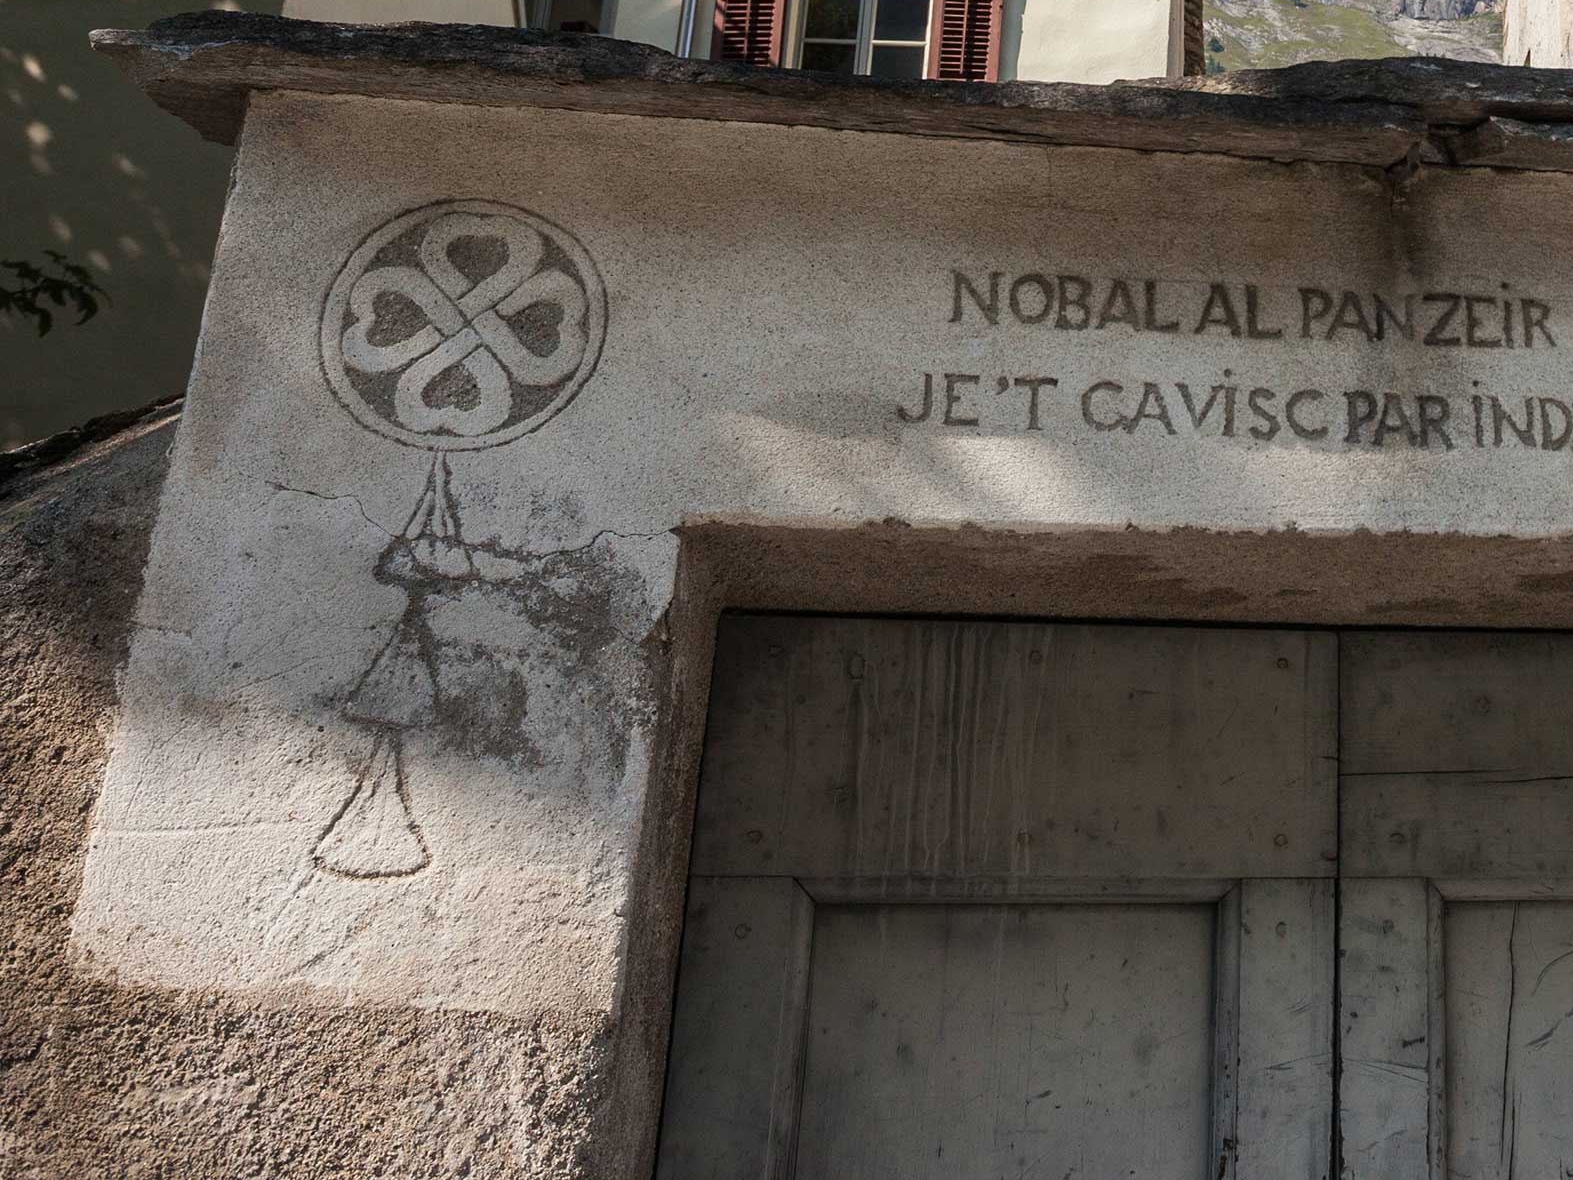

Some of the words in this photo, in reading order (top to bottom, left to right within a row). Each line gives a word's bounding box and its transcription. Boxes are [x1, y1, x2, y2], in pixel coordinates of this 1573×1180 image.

[948, 269, 1180, 331] NOBAL
[1194, 281, 1283, 339] AL
[1343, 388, 1454, 450] PAR
